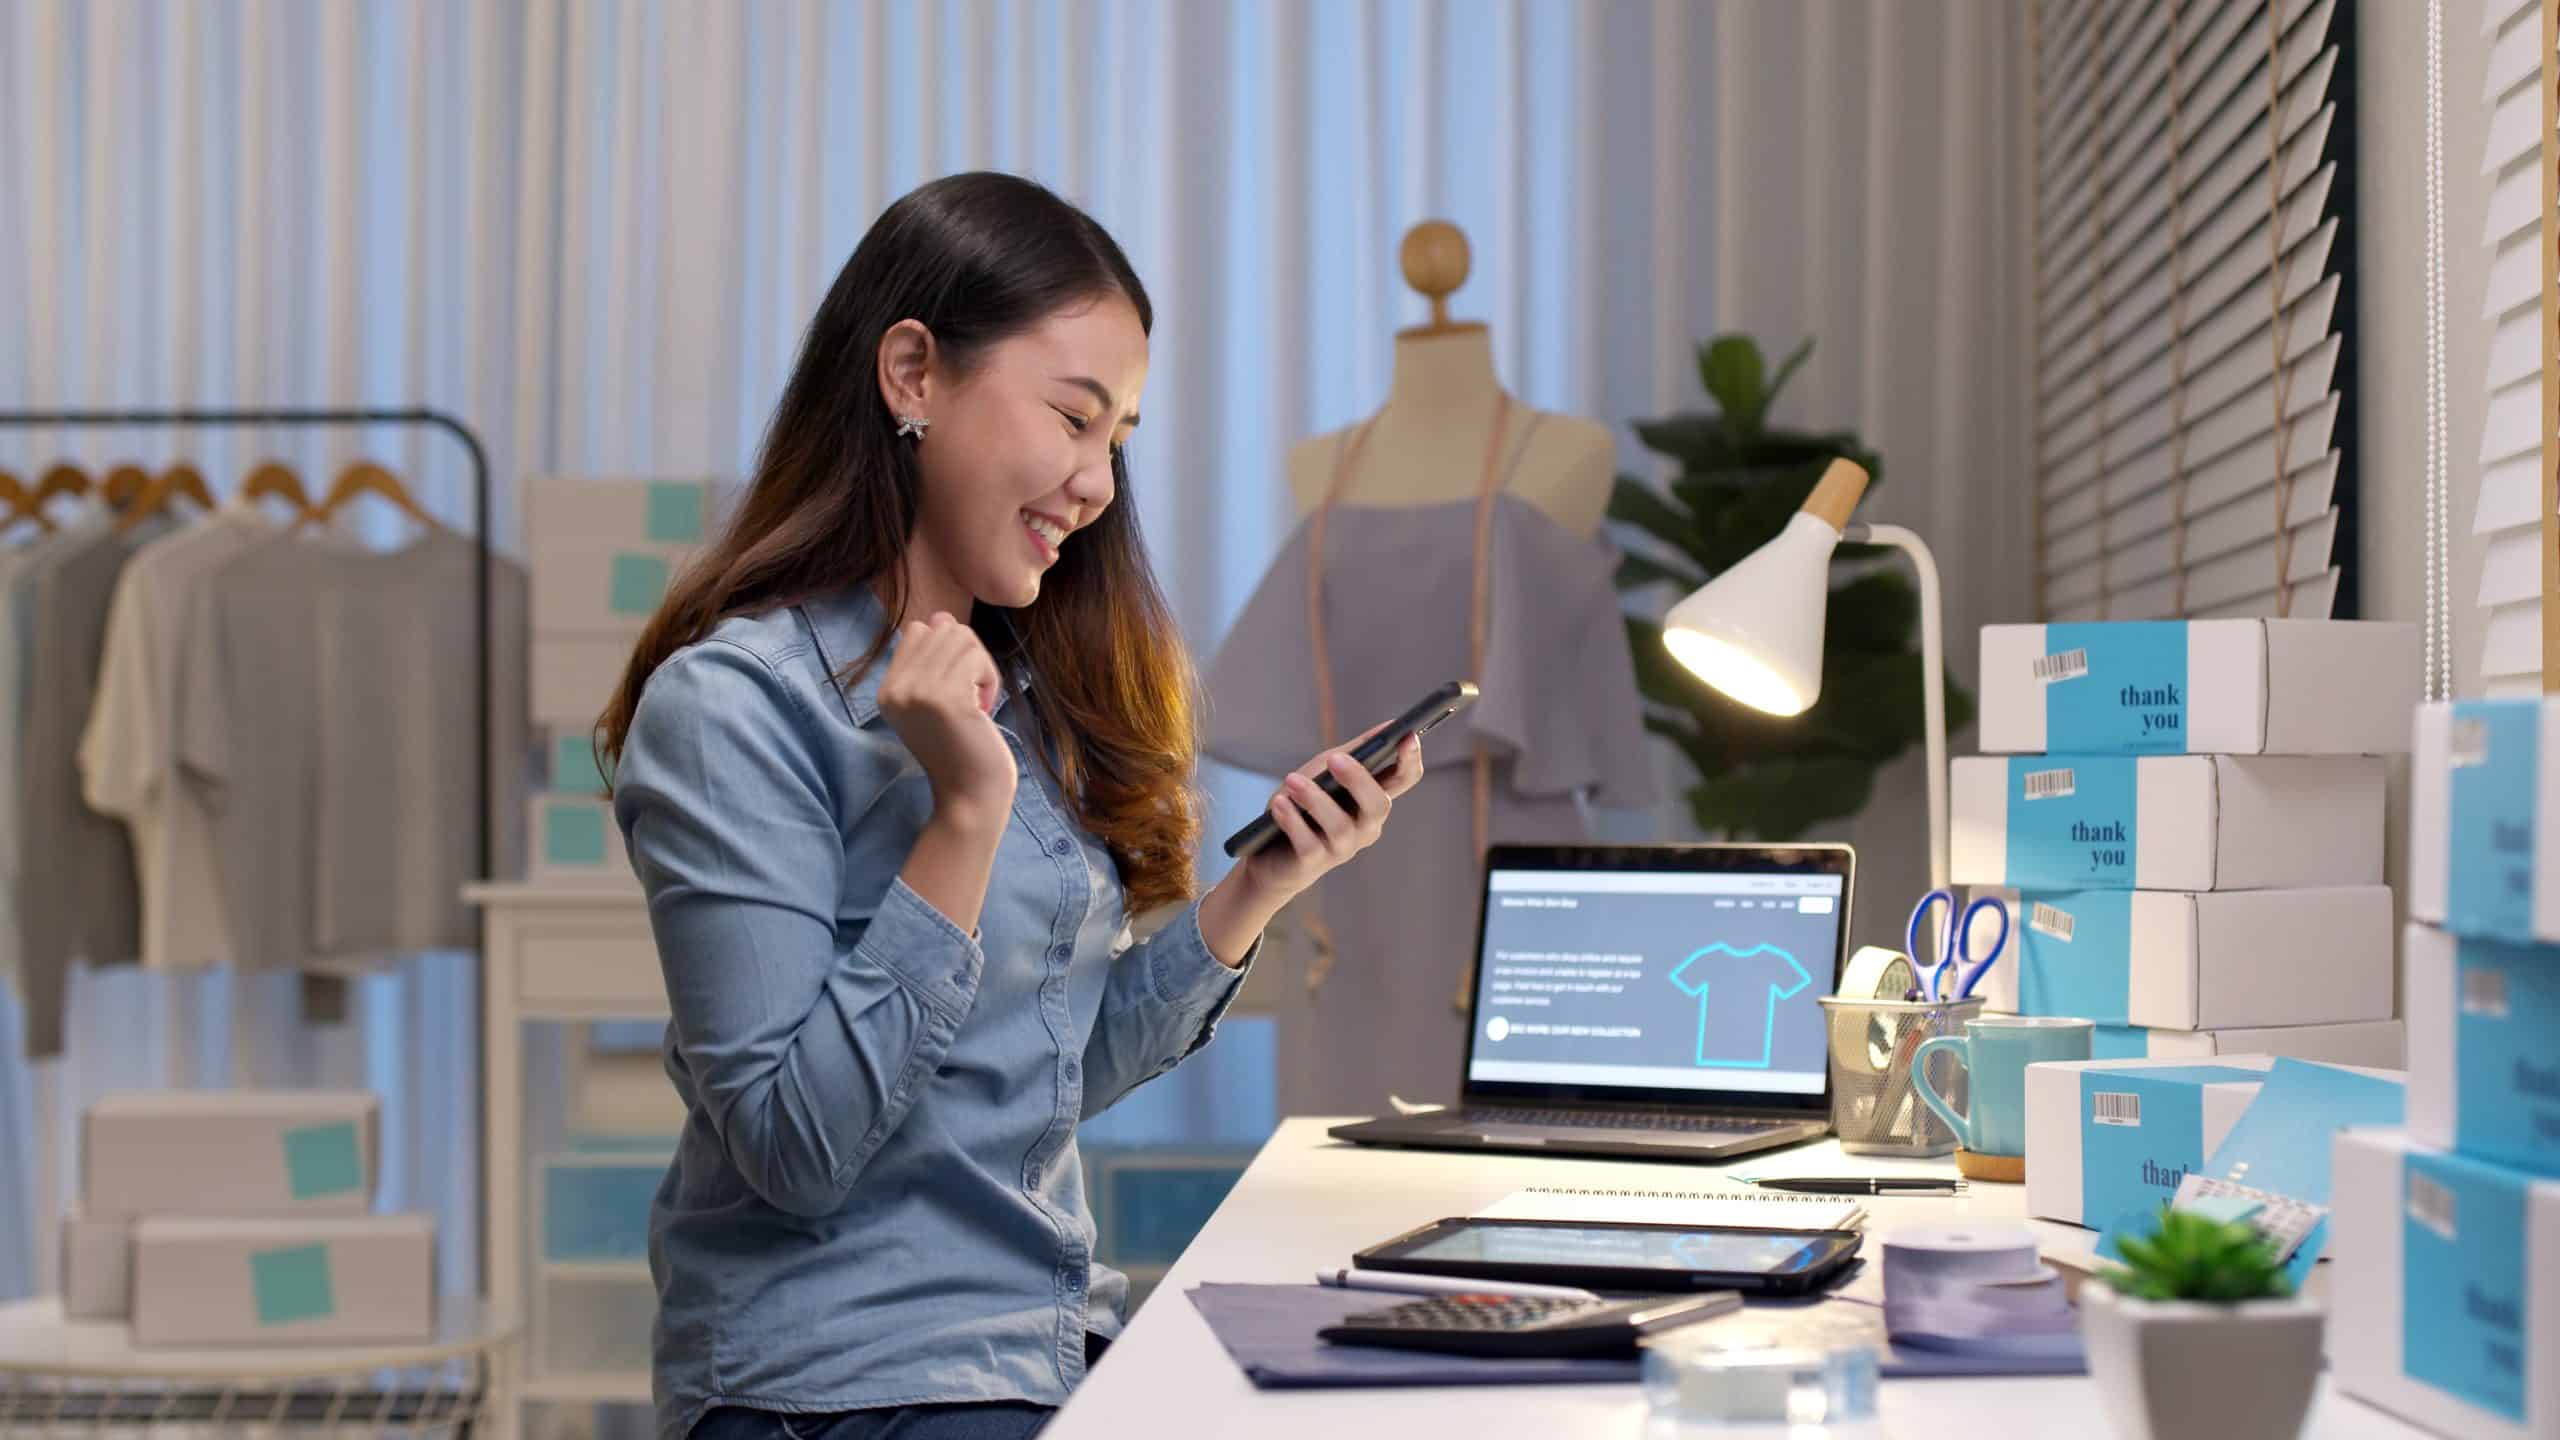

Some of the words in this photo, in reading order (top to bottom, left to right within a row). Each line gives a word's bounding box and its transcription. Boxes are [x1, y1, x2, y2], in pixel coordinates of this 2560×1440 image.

[2120, 683, 2180, 706] thank
[2141, 713, 2179, 737] you
[2071, 820, 2126, 842] thank
[2090, 849, 2125, 872] you
